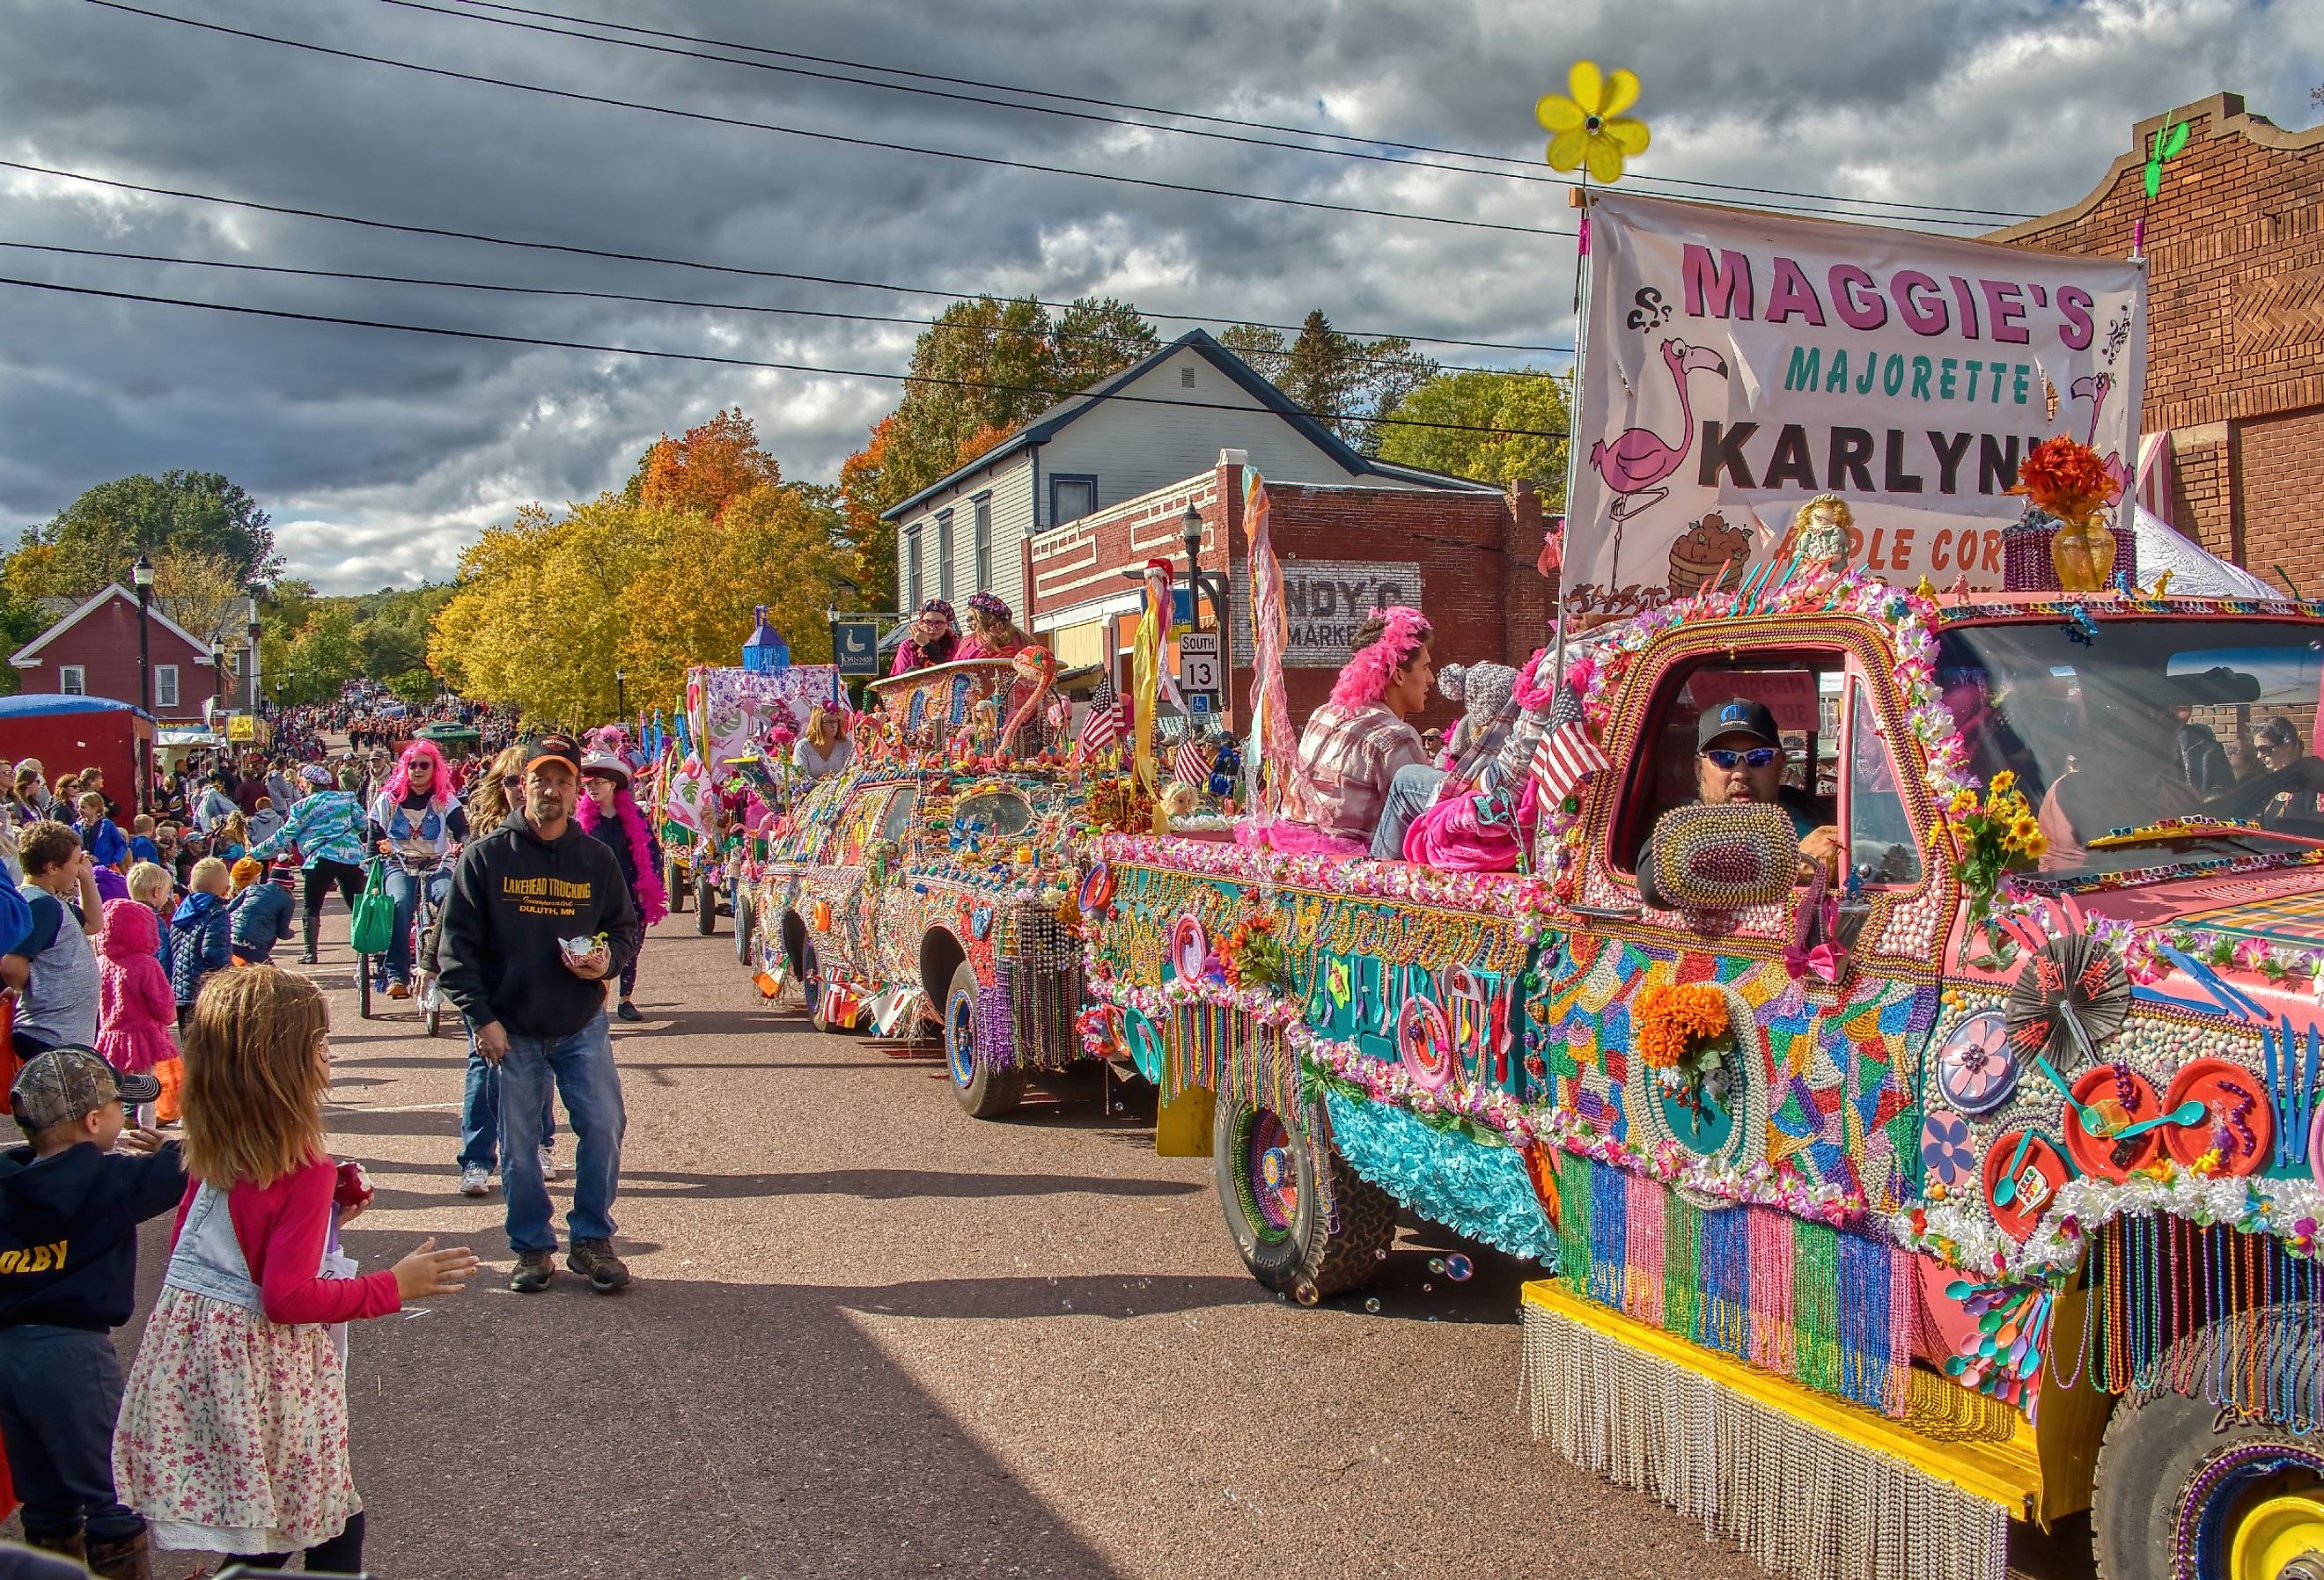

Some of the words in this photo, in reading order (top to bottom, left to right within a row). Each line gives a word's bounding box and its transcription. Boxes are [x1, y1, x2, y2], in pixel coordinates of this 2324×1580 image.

[1682, 243, 2094, 351] MAGGIE'S
[1785, 346, 2030, 404] MAJORETTE
[1697, 420, 2041, 495] KARLYN
[1773, 526, 1916, 571] APLE
[1932, 528, 2003, 573] COR
[1182, 636, 1214, 650] SOUTH
[1188, 663, 1212, 686] 13
[503, 876, 547, 896] LAKEHEAD
[548, 878, 591, 899] TRUCKING
[519, 904, 559, 915] DULUTH,
